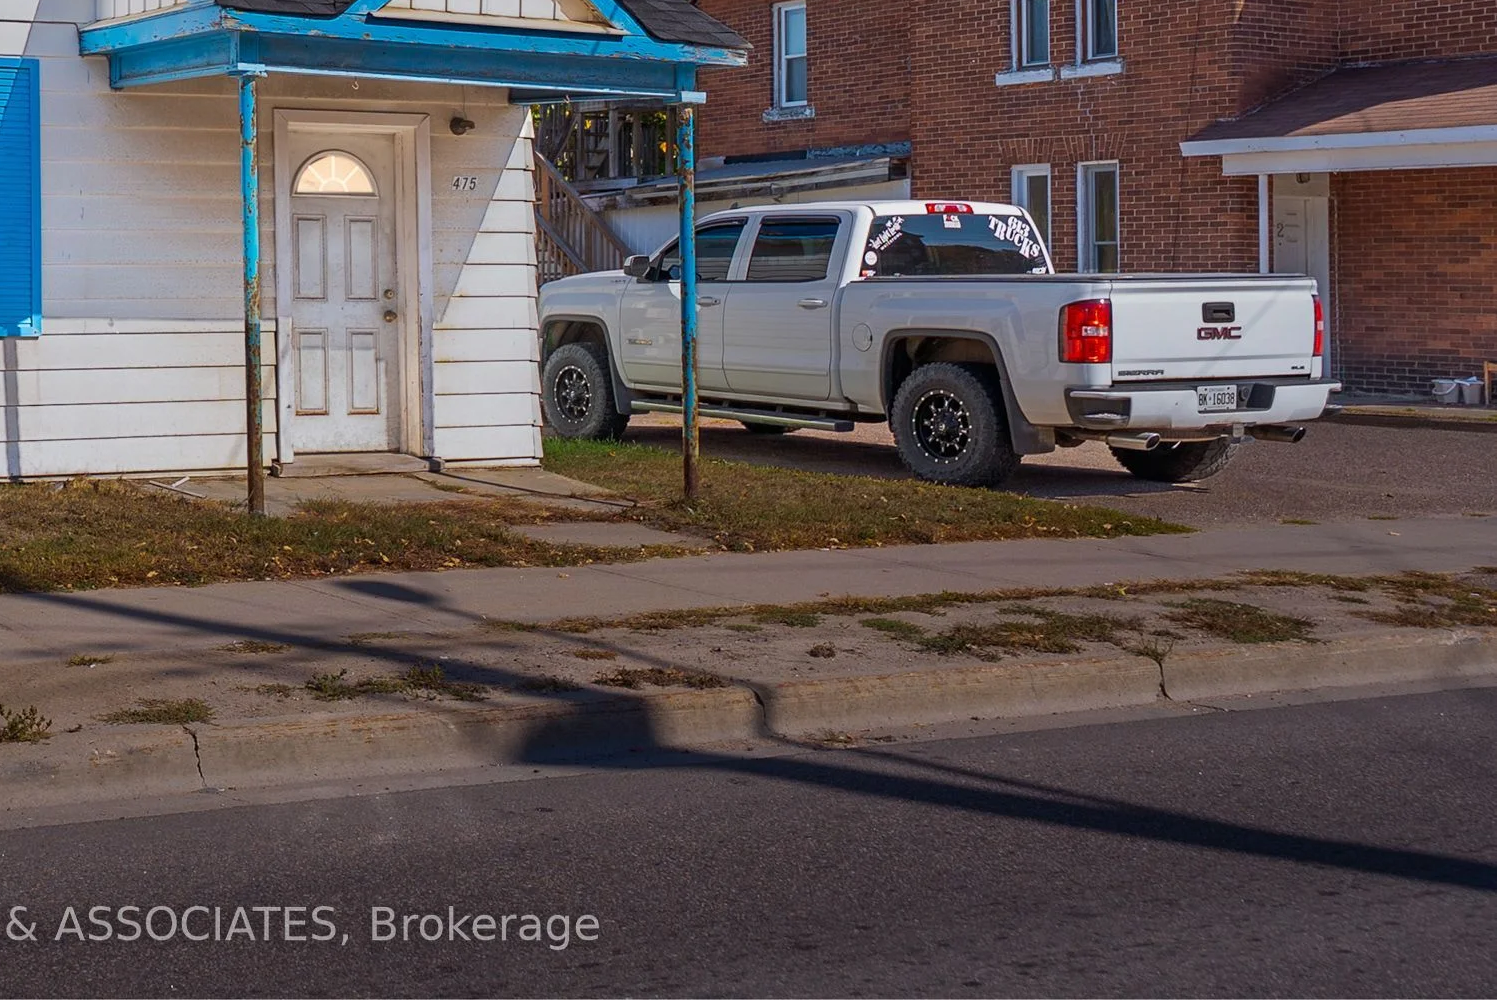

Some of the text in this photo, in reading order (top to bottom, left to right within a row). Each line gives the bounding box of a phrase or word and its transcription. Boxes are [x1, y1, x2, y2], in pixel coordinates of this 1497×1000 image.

[452, 176, 477, 191] 475
[1007, 216, 1031, 238] 613
[1276, 222, 1285, 238] 2
[988, 215, 1041, 259] TRUCKS
[1196, 326, 1242, 341] GMC
